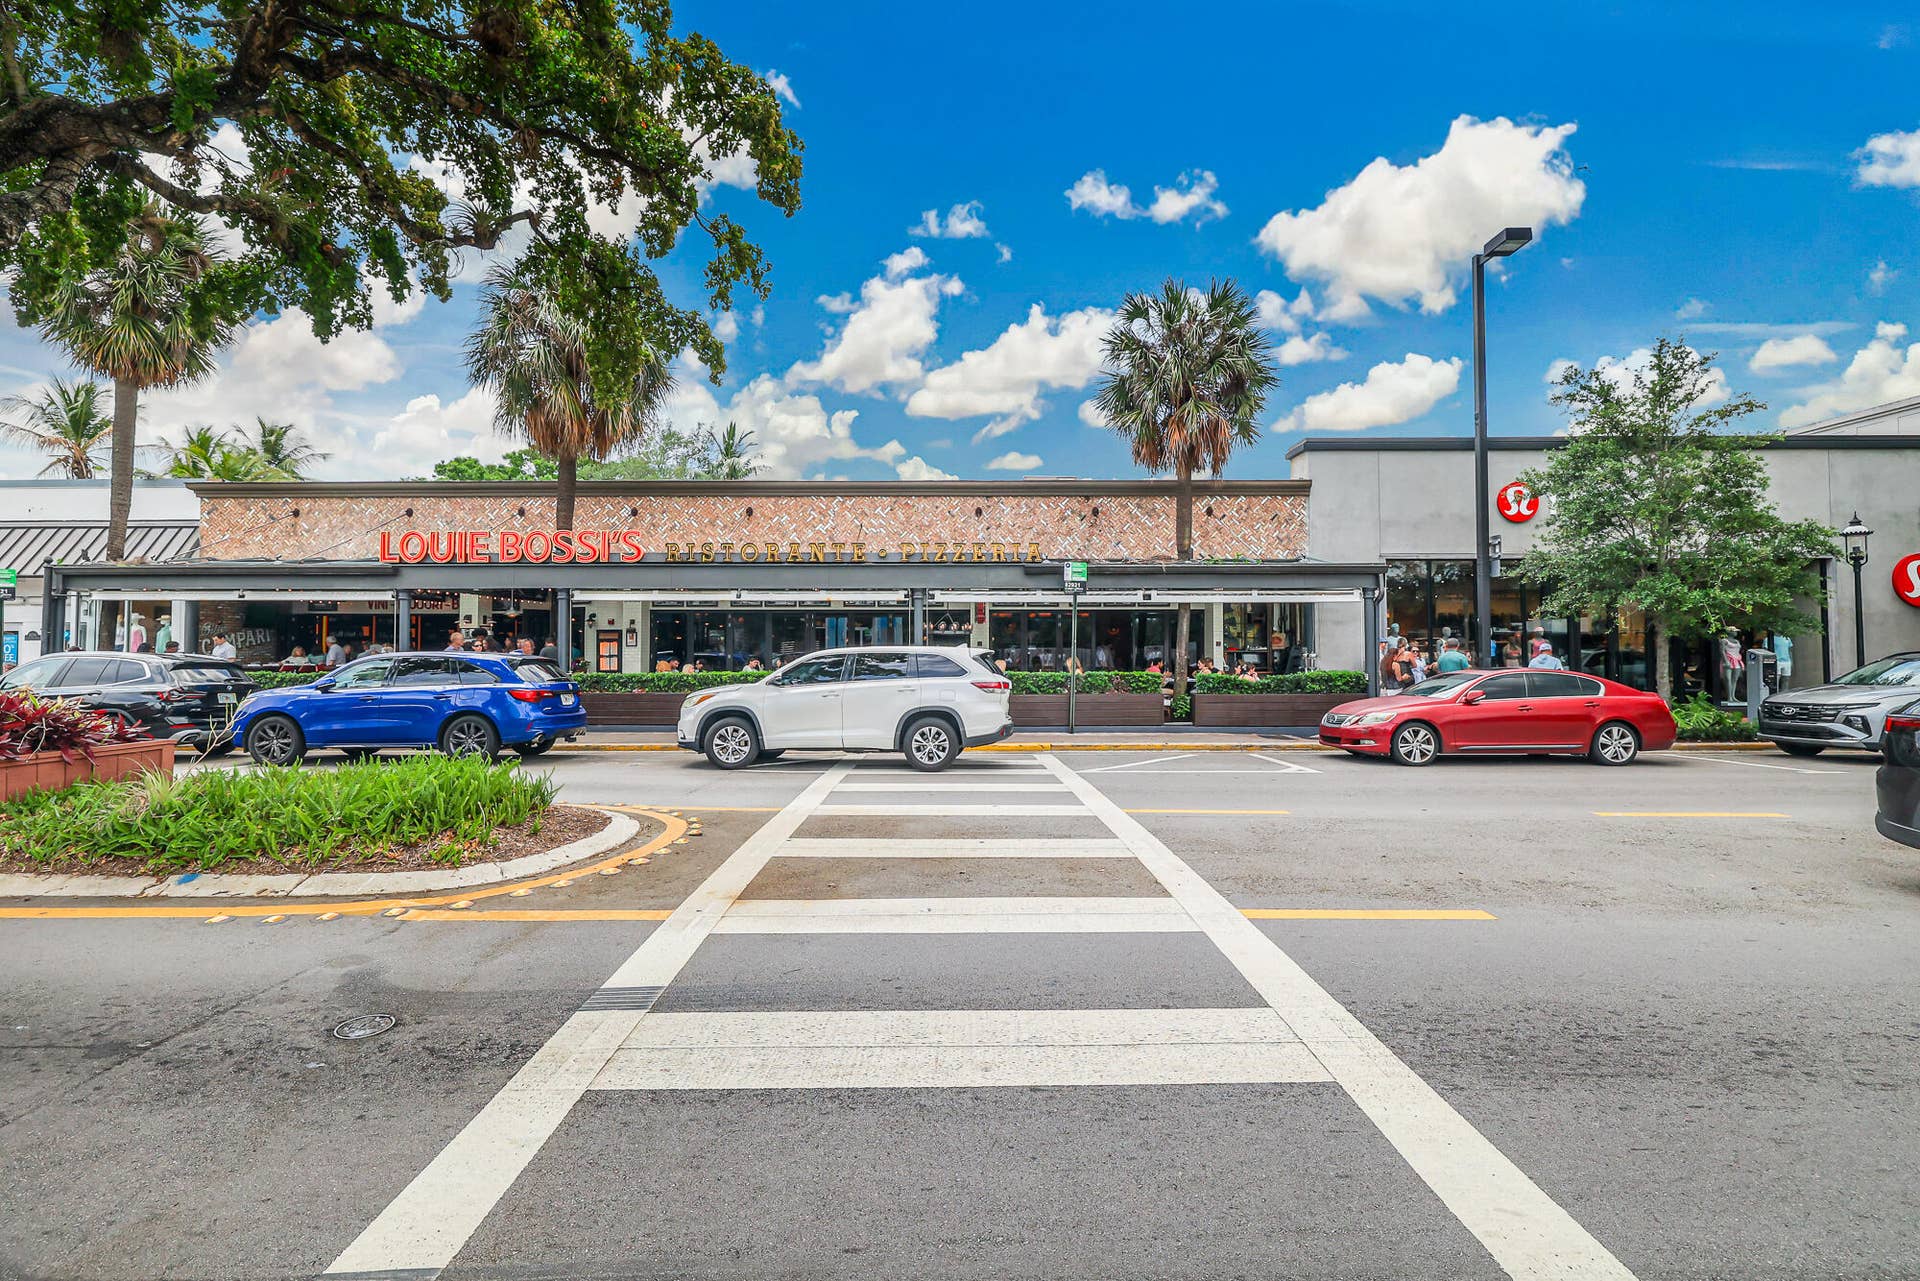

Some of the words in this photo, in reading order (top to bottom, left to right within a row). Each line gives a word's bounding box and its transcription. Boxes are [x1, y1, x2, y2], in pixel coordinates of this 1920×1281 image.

[379, 530, 491, 564] LOUIE
[499, 529, 646, 564] BOSSI'S
[665, 542, 867, 563] RISTORANTE
[899, 542, 1044, 563] PIZZERIA
[201, 628, 270, 656] CMPARI
